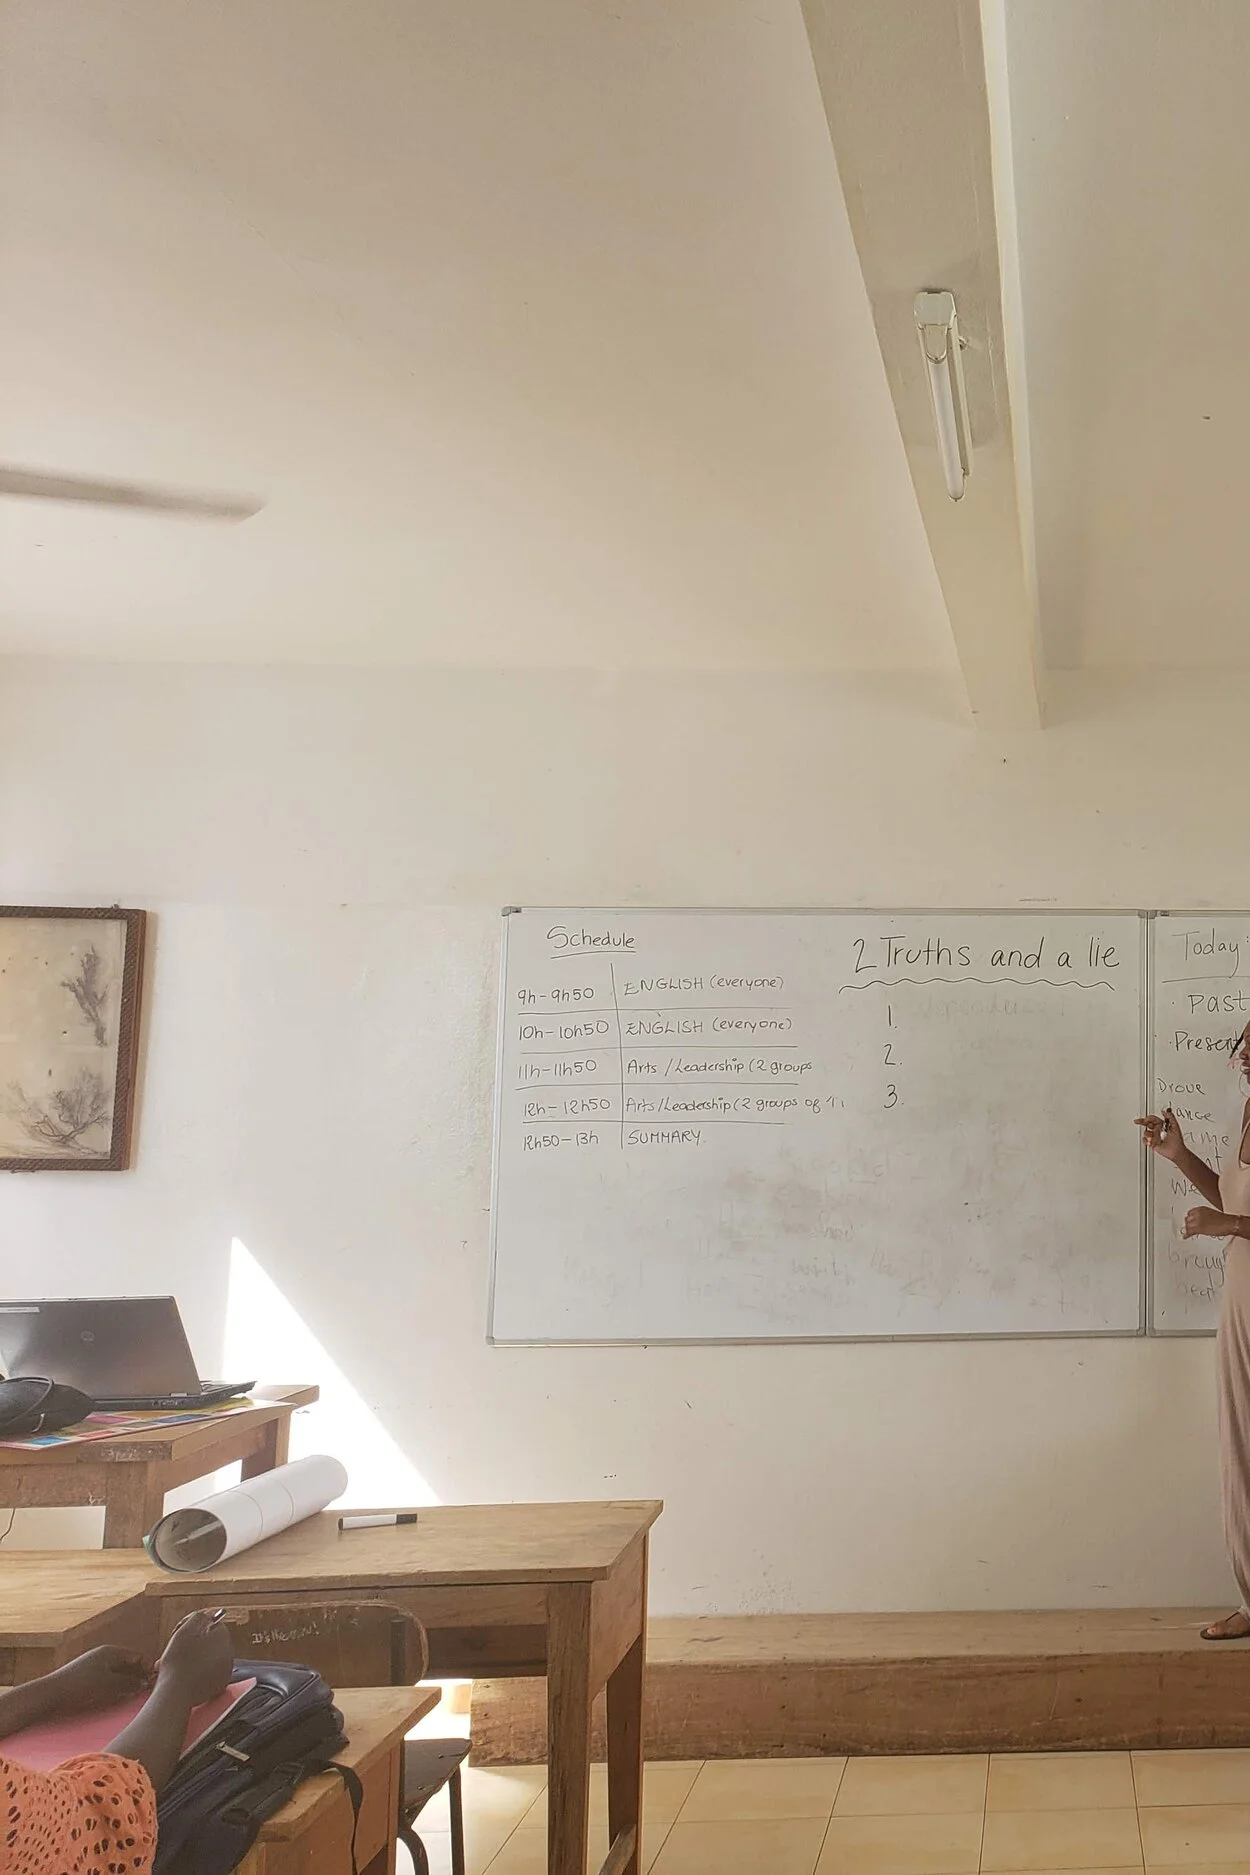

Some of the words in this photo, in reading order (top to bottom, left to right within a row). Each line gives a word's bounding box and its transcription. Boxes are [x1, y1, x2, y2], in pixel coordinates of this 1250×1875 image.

[547, 926, 636, 949] Schedule
[853, 938, 877, 973] 2
[880, 935, 972, 968] Truths
[991, 936, 1044, 969] and
[1057, 952, 1073, 969] a
[1089, 936, 1120, 969] lie
[624, 976, 704, 996] ENGLISH
[709, 974, 785, 993] (everyone)
[1187, 990, 1250, 1014] Past
[625, 1018, 703, 1036] ENGLISH
[712, 1017, 792, 1033] (everyone)
[770, 1061, 813, 1075] groups
[756, 1098, 798, 1112] groups
